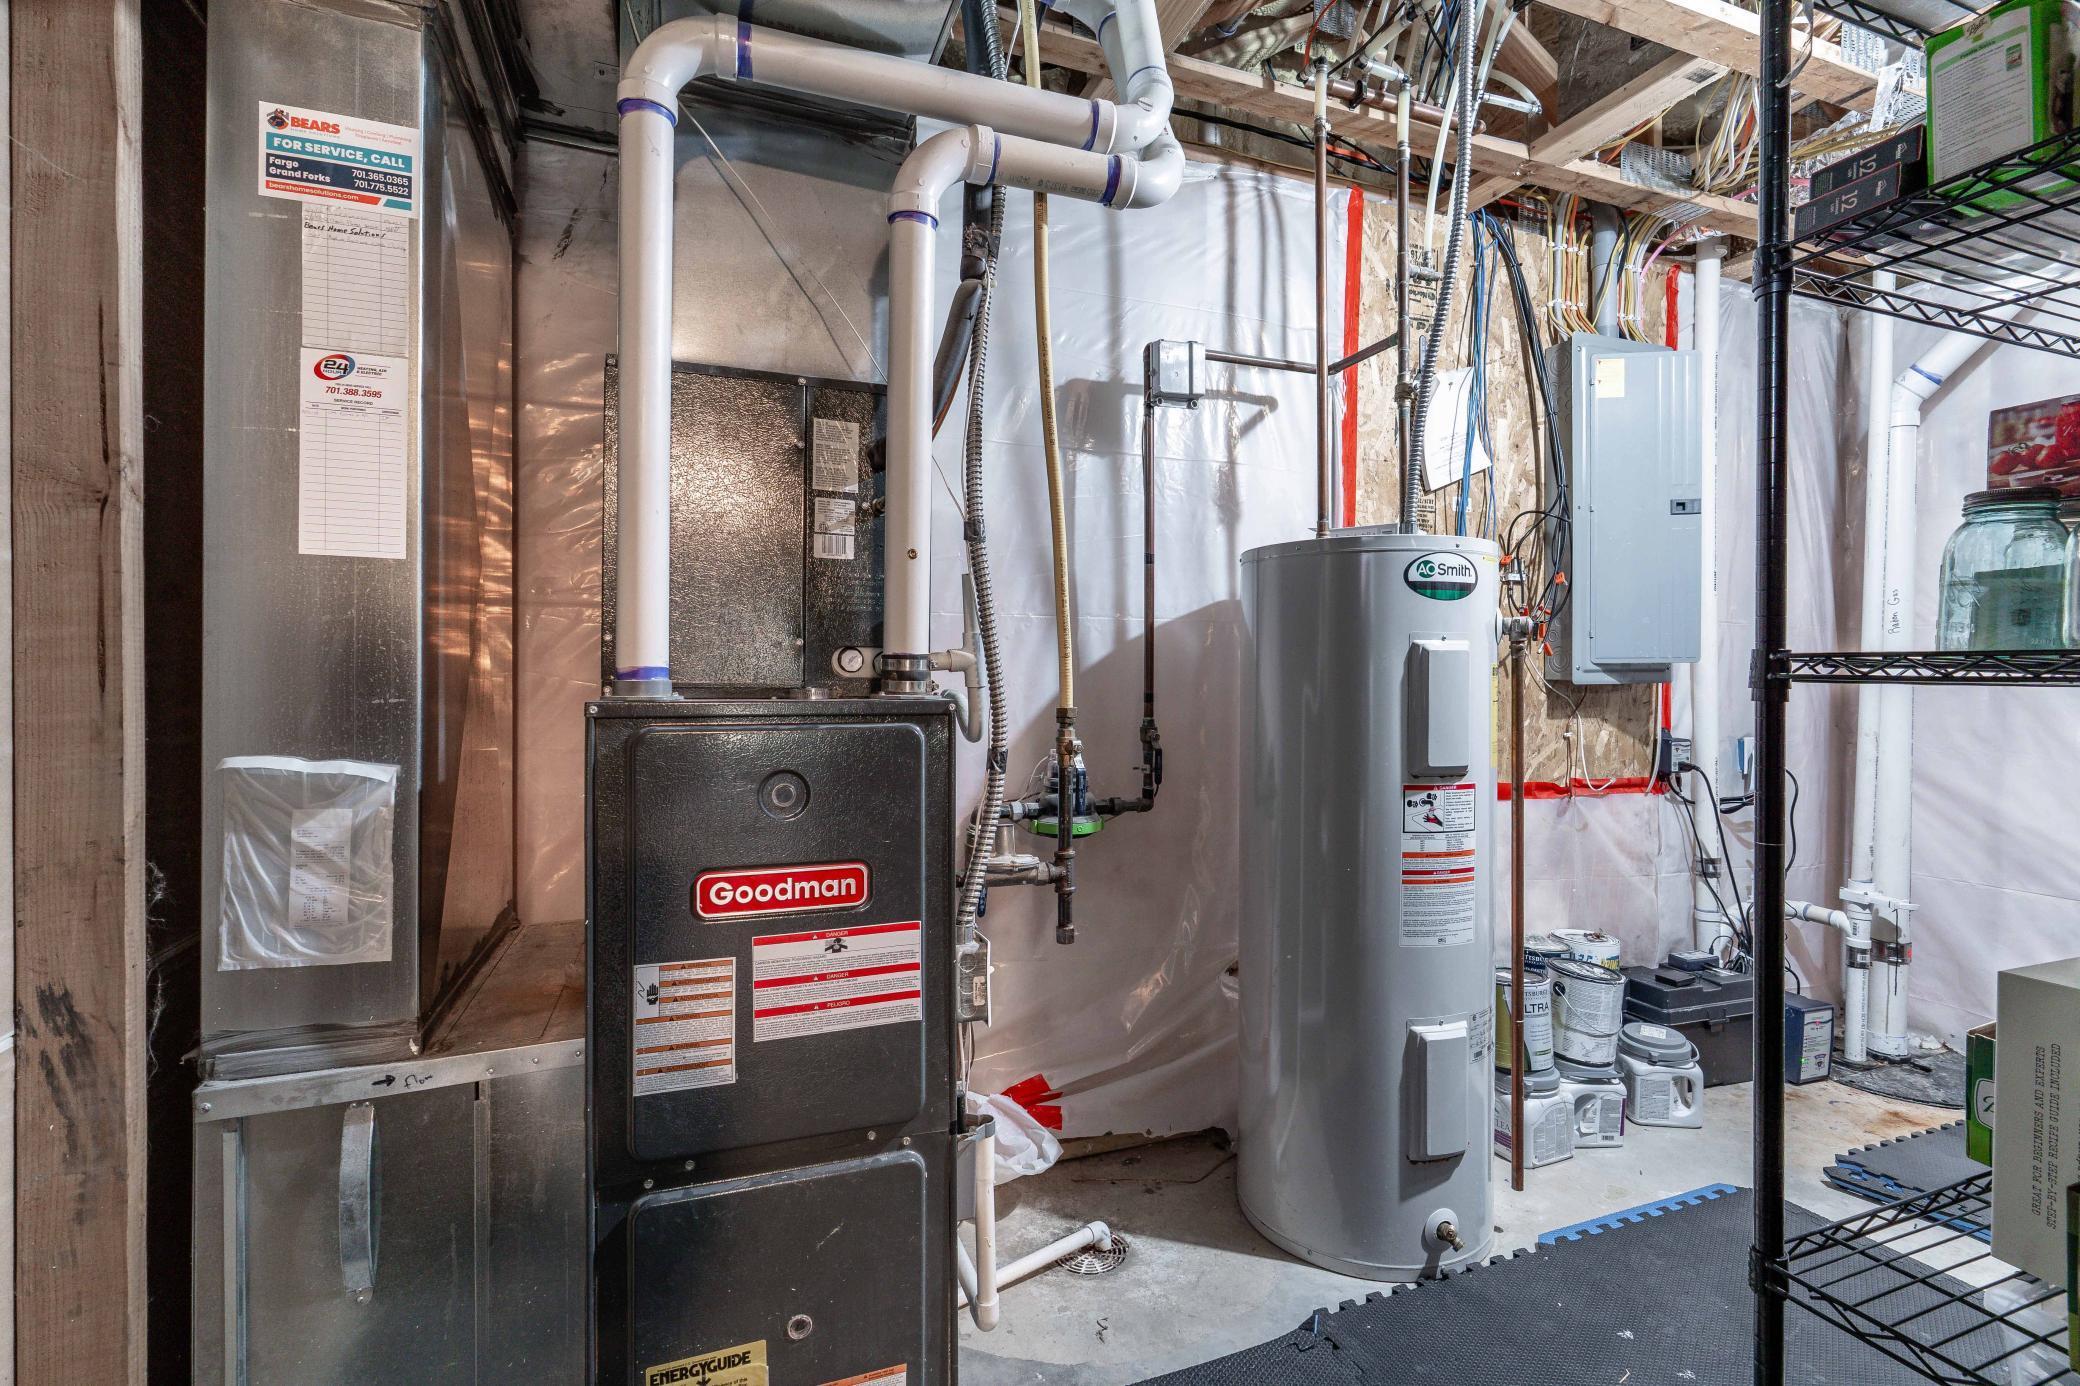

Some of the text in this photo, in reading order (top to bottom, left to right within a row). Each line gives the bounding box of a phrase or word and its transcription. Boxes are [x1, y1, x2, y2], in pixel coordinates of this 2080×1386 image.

[290, 116, 341, 135] BEARS
[273, 137, 405, 168] FOR SERVICE, CALL
[269, 156, 299, 168] Fargo
[269, 166, 331, 183] Grand Forks
[351, 169, 409, 186] 701.365.0365
[268, 182, 359, 201] bearshomesolutions.com
[354, 179, 409, 195] 701.775.5522
[324, 359, 349, 375] 24
[325, 386, 382, 398] 701.388.3595
[1437, 563, 1471, 577] Smith
[709, 877, 857, 906] Goodman
[826, 972, 849, 980] DANGER
[1524, 1003, 1549, 1014] LTRA
[1496, 1120, 1511, 1132] LEA
[2032, 1045, 2045, 1216] GREAT FOR BEGINNERS AND EXPERTS
[2046, 1043, 2061, 1230] STEP-BY-STEP RECIPE GUIDE INCLUDED
[650, 1350, 751, 1386] ENERGYGUIDE
